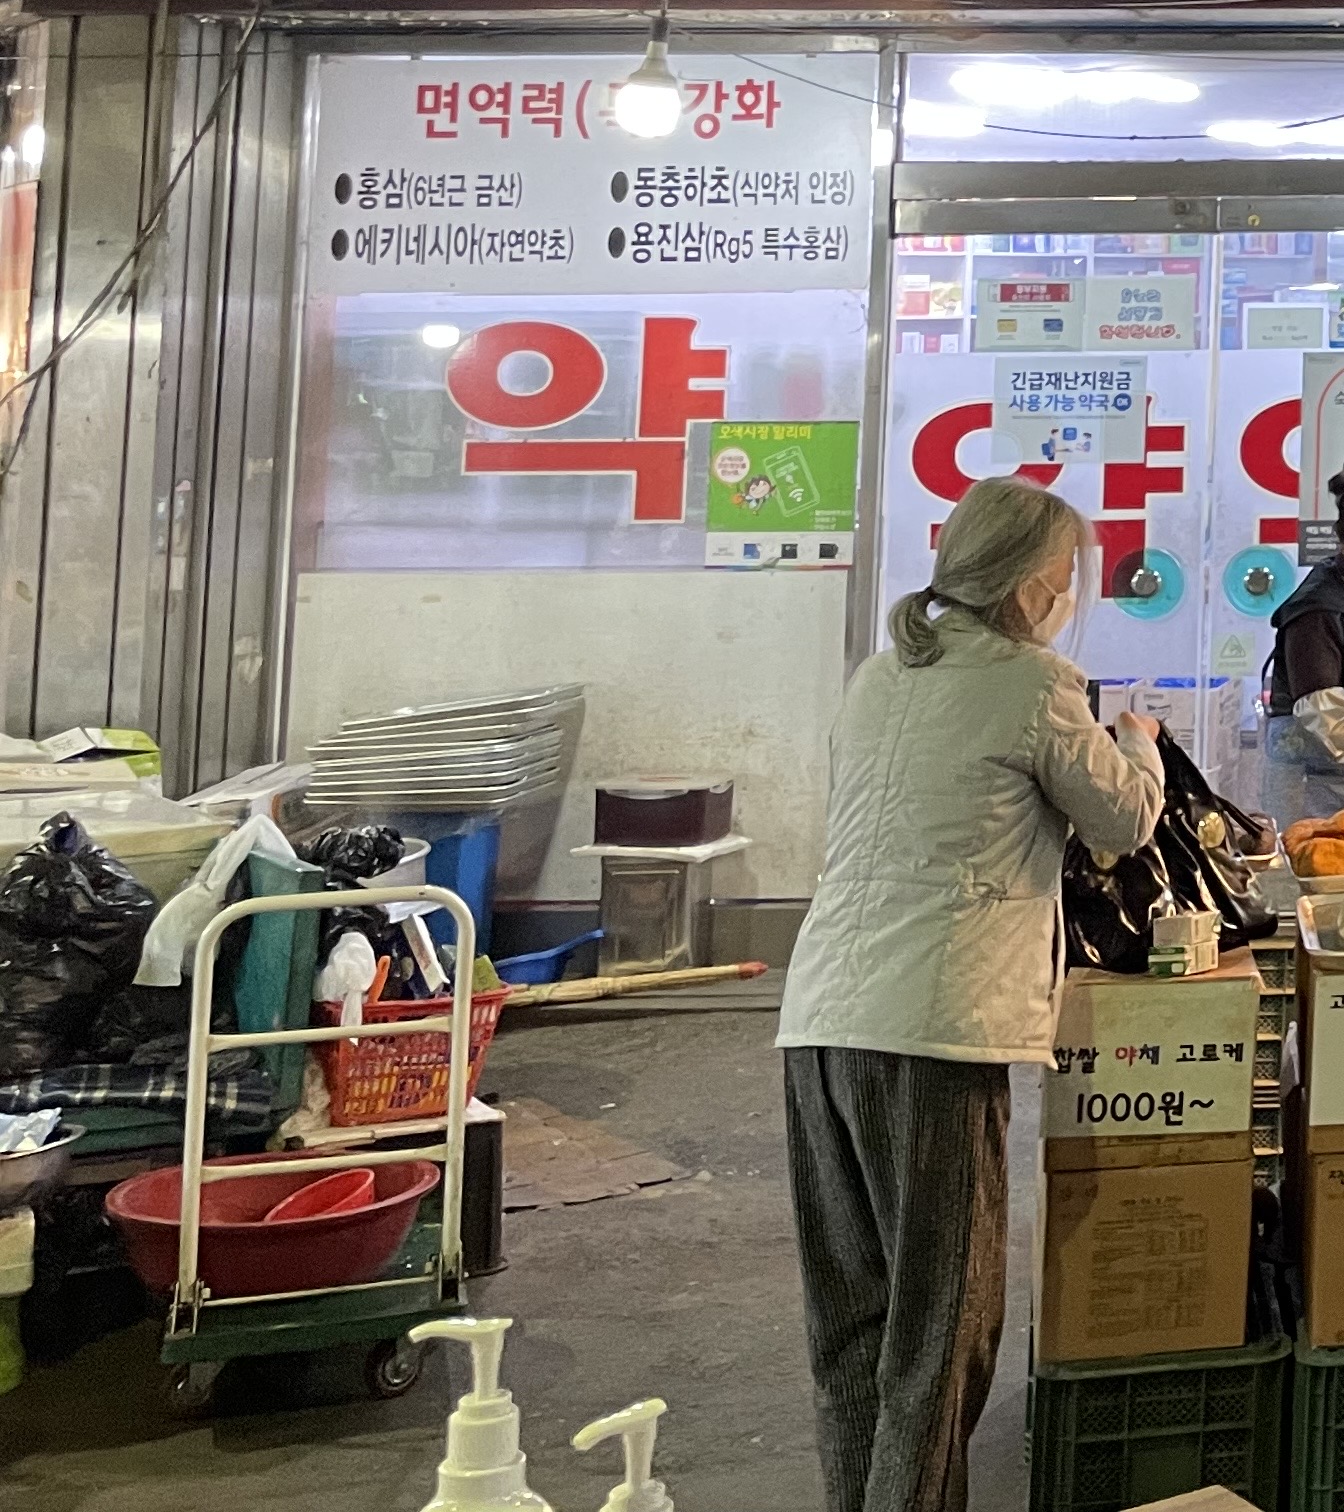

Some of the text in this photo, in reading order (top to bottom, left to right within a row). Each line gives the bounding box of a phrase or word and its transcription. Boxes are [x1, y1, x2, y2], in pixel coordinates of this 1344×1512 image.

[417, 78, 783, 141] 면역력(강화
[356, 166, 523, 210] 홍삼(6년근 금산)
[633, 165, 855, 207] 동충하초(식약처 인정)
[353, 222, 575, 266] 에키네시아(자연약초)
[630, 220, 849, 264] 용진삼(Rg5 특수홍삼)
[1008, 394, 1041, 412] 사용
[1044, 393, 1076, 412] 가능
[1079, 393, 1110, 412] 약국
[1010, 371, 1132, 391] 긴급재난지원금
[447, 317, 728, 521] 약
[1114, 1043, 1162, 1068] 야채
[1174, 1041, 1245, 1064] 고로케
